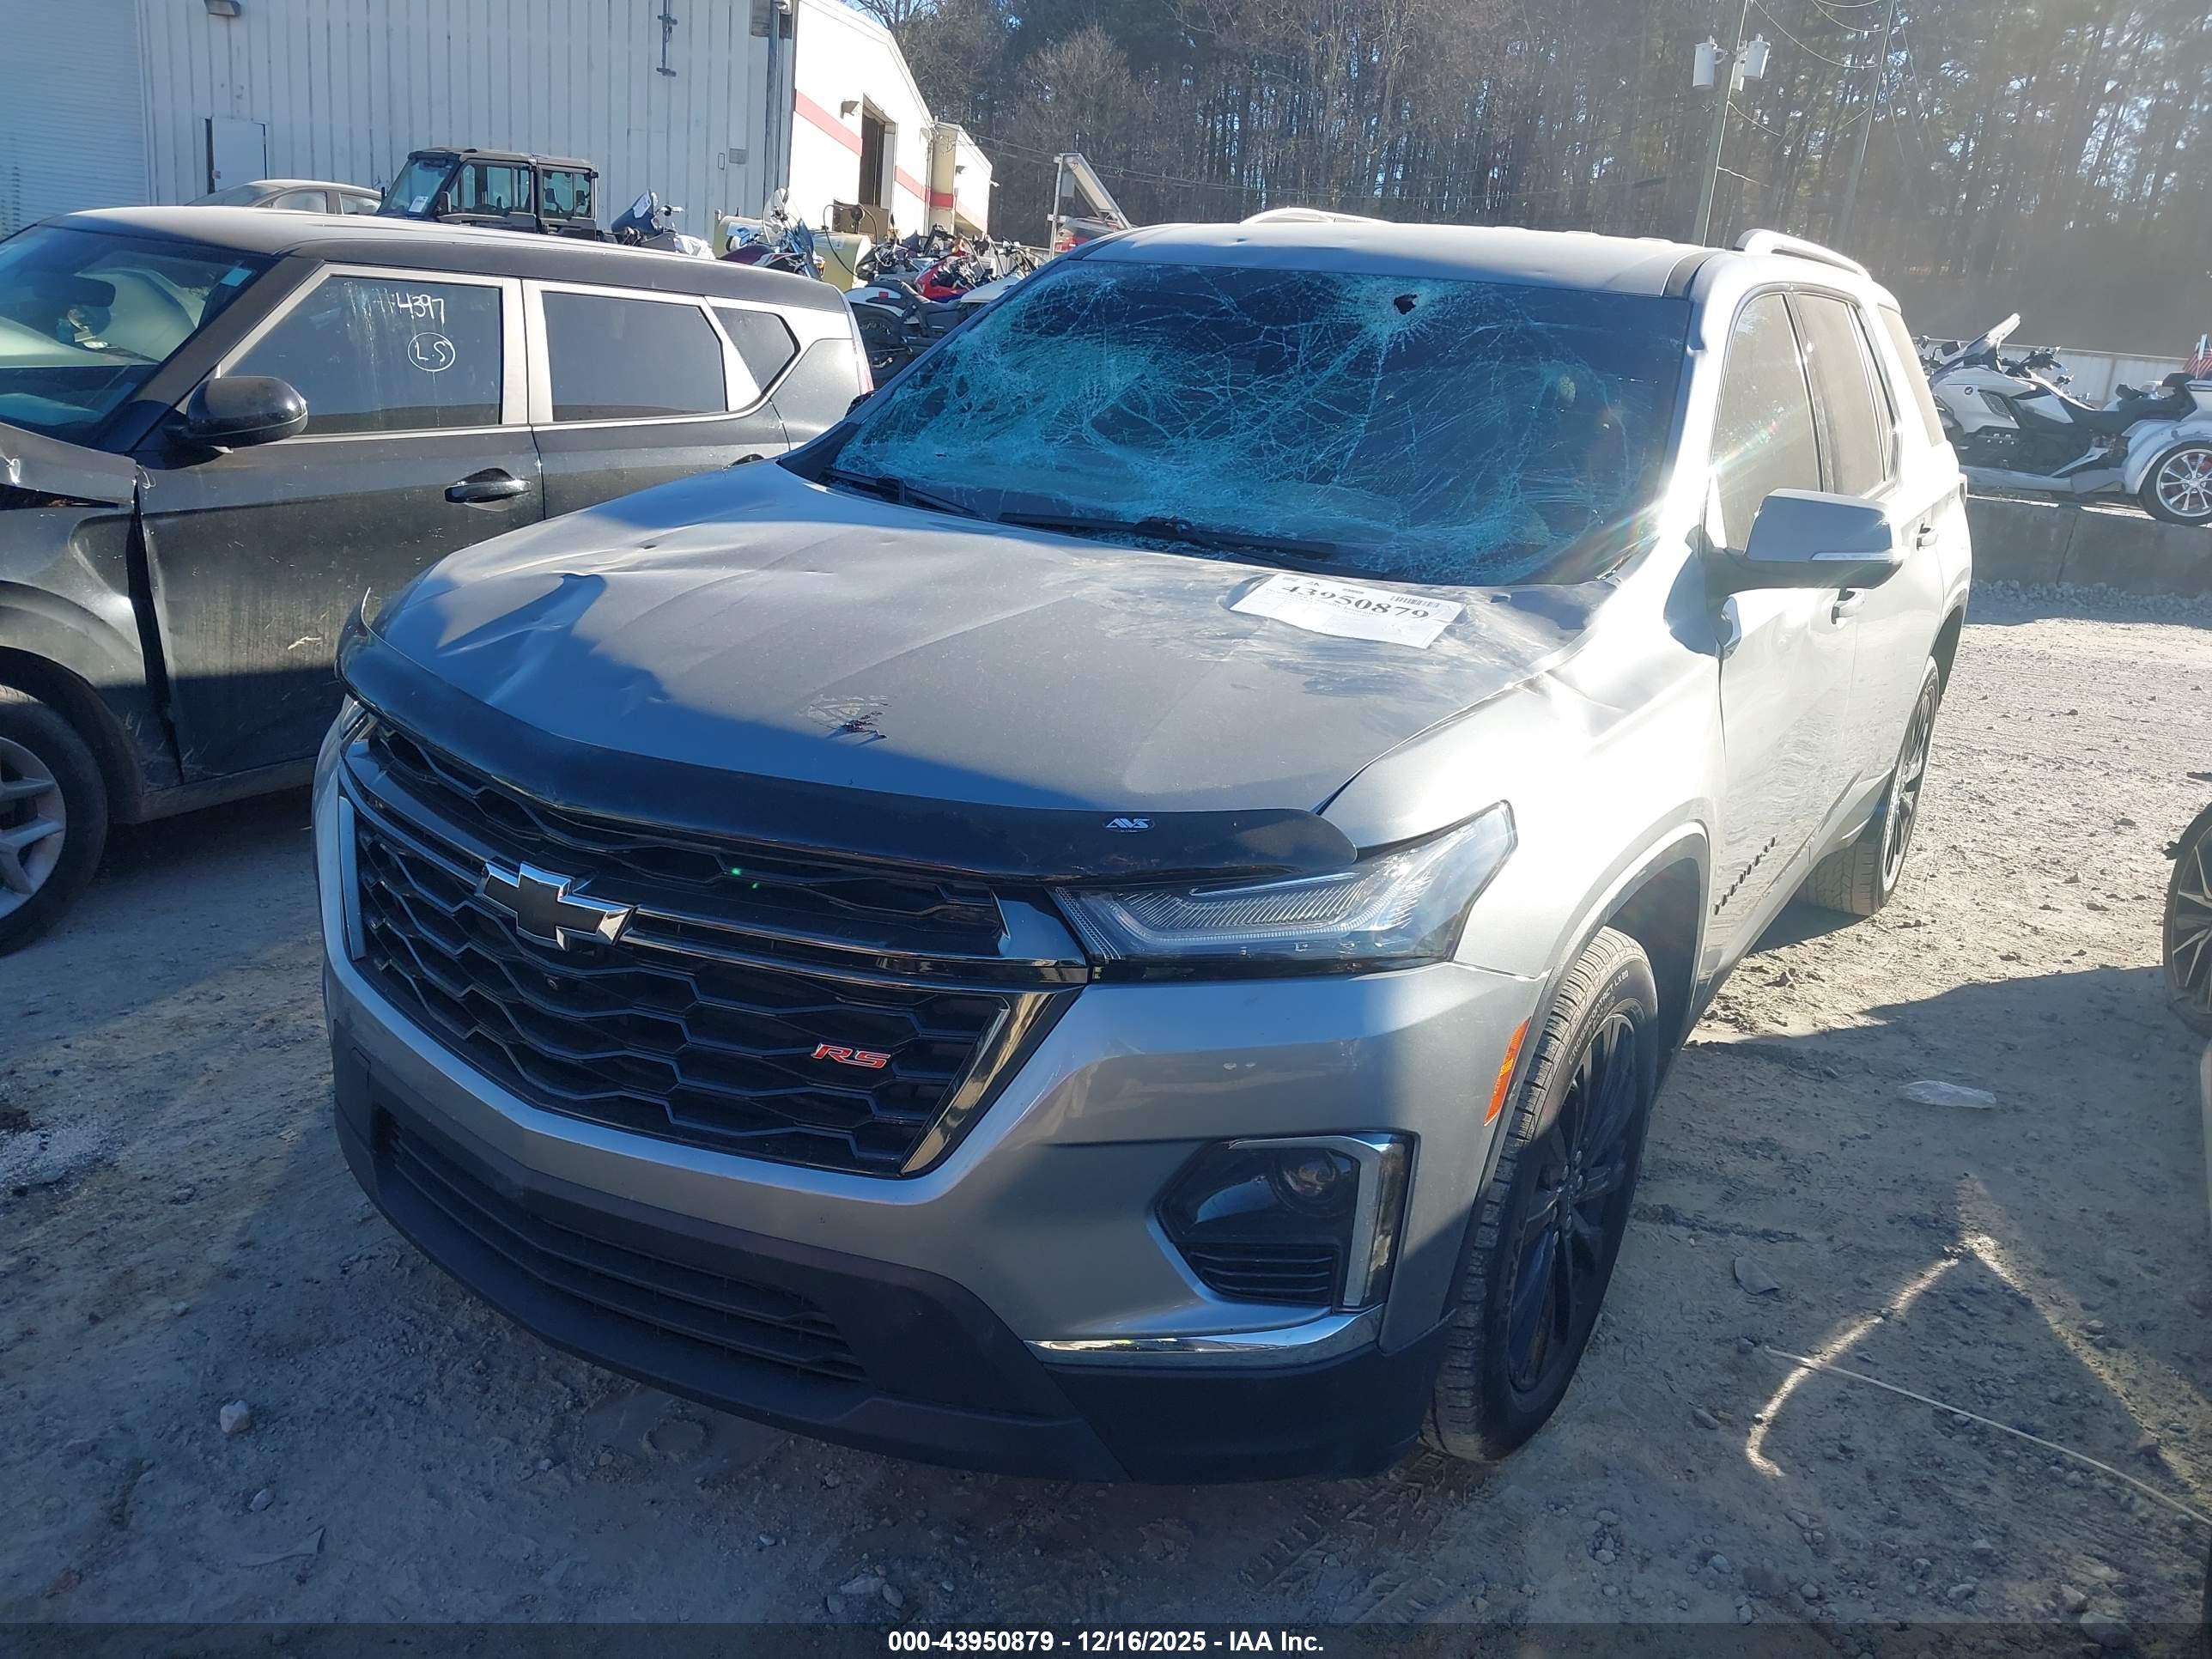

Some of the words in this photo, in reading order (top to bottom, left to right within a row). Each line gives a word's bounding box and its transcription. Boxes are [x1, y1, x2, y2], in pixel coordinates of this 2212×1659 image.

[396, 292, 445, 324] 4397
[1281, 585, 1430, 619] 43950879
[1105, 817, 1151, 829] AVS
[811, 1042, 891, 1069] RS
